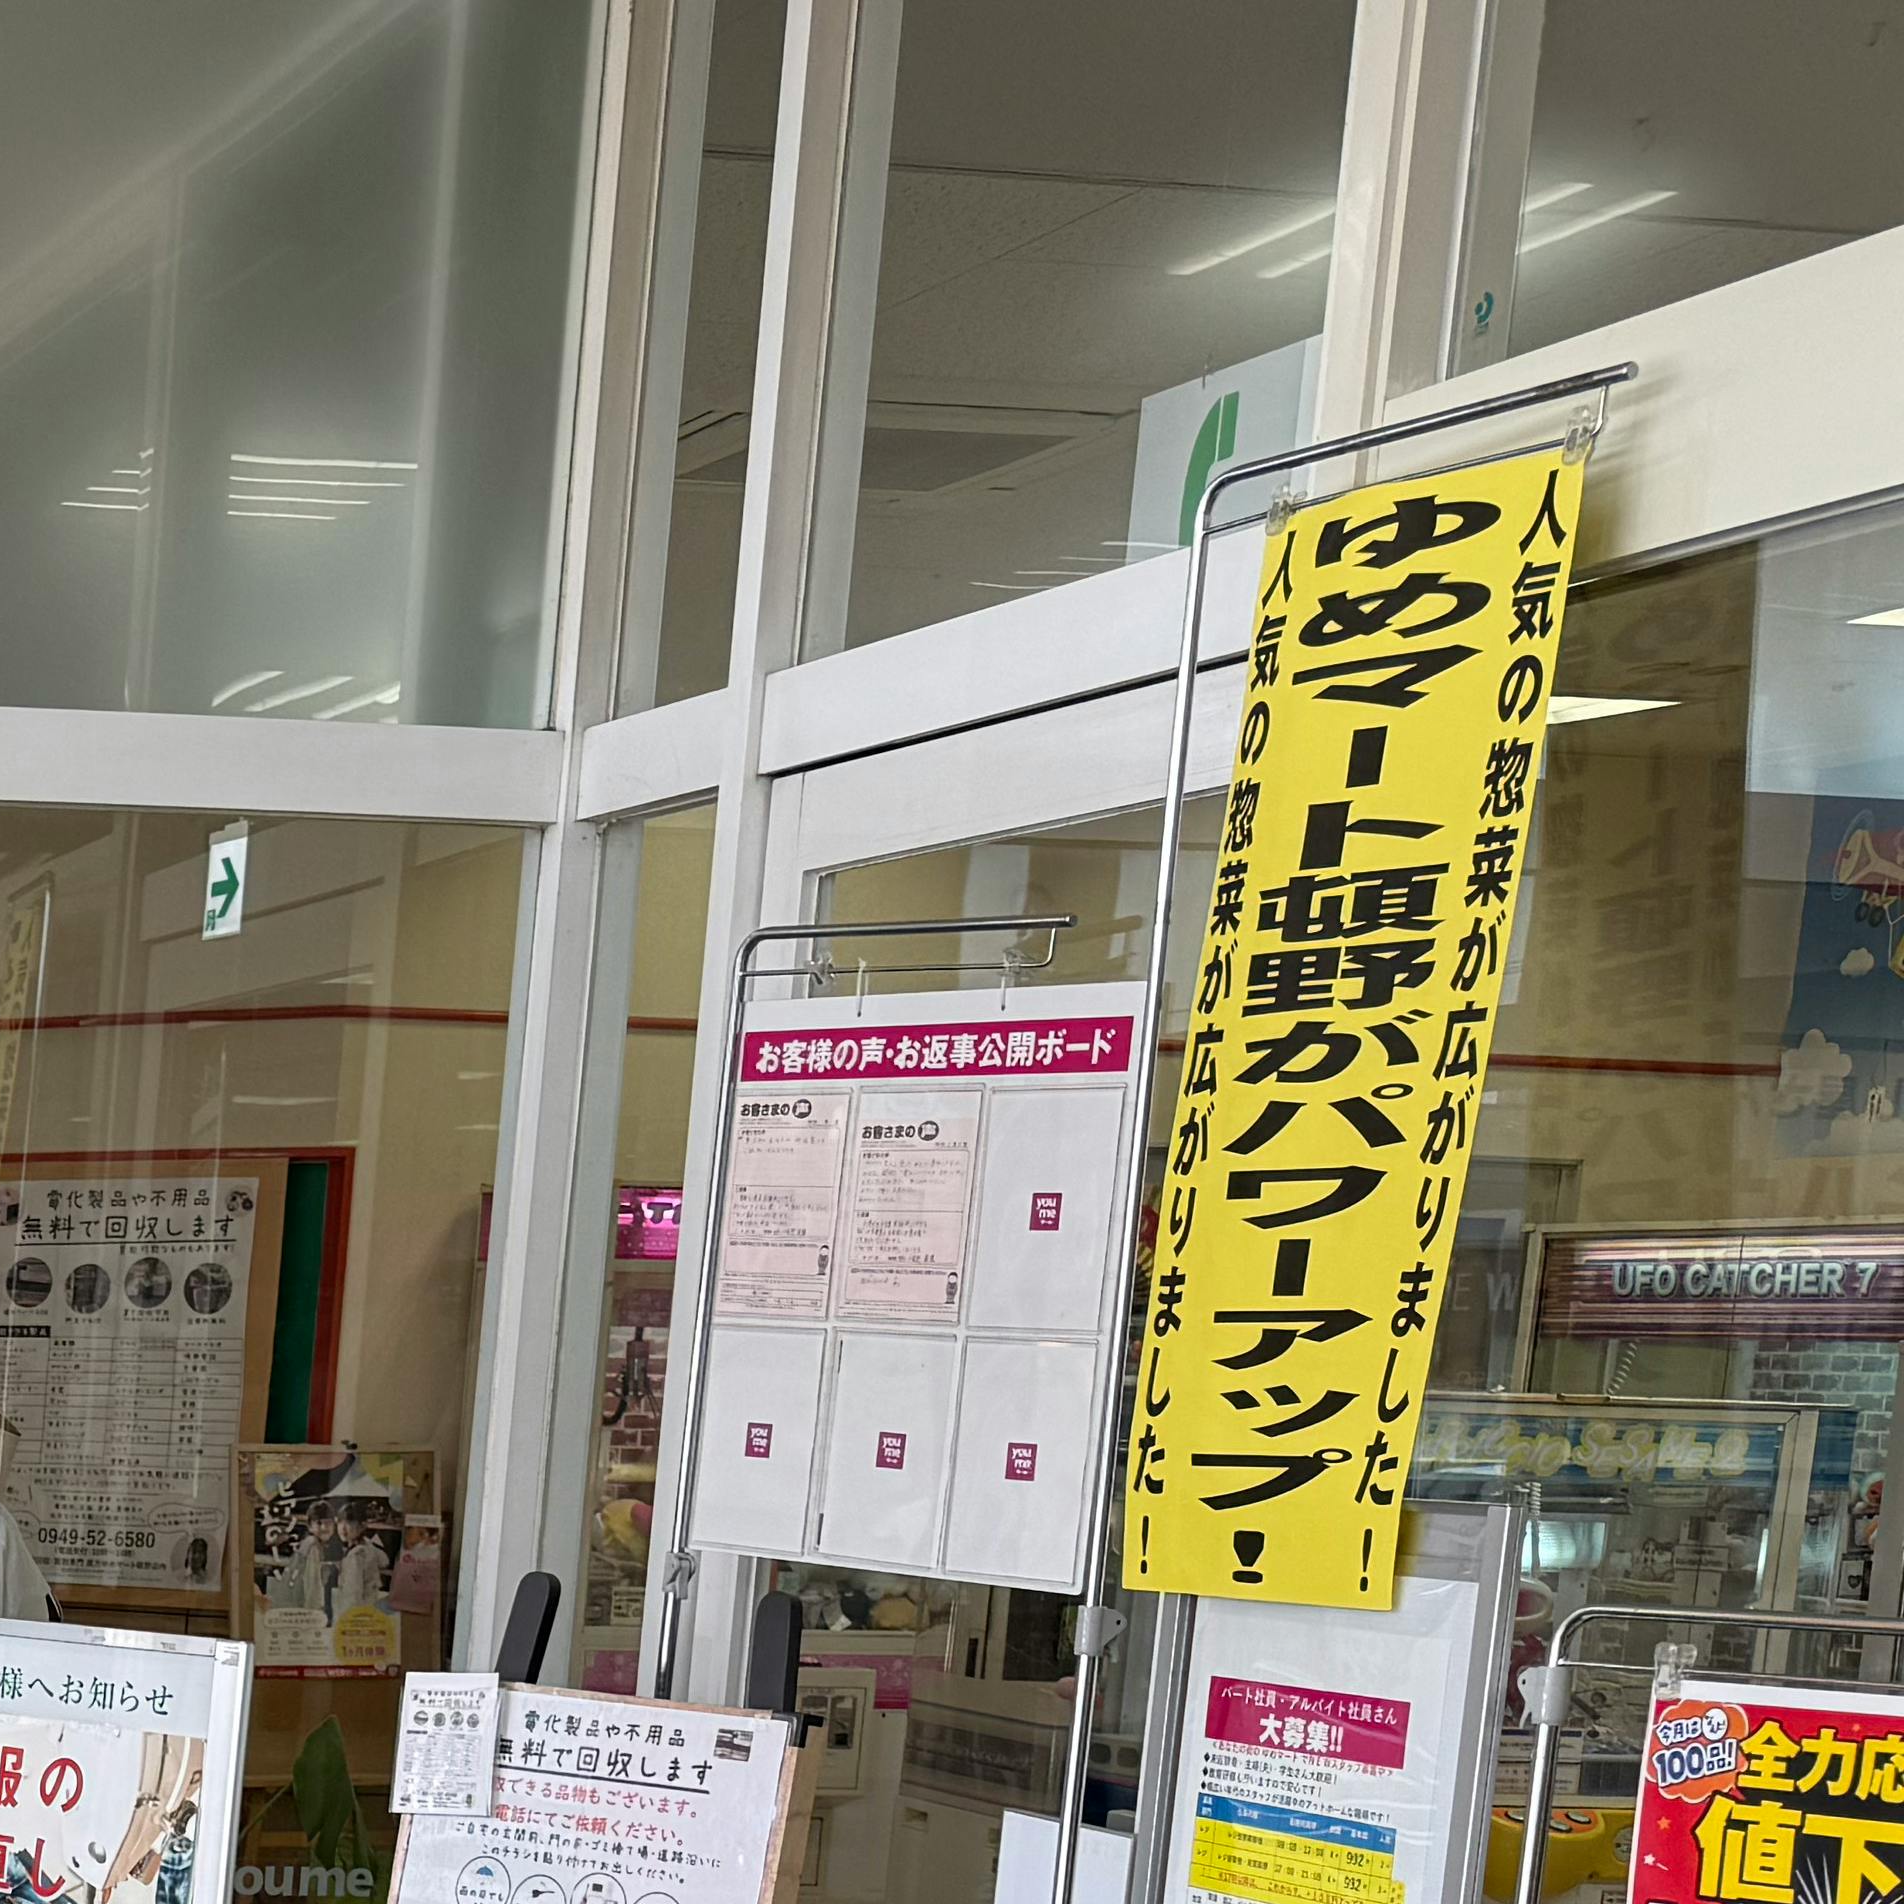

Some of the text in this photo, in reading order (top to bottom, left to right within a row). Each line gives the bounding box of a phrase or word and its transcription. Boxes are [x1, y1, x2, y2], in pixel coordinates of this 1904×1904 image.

[1192, 495, 1501, 1584] ゆめマート頓野がパワーアップ!
[1354, 469, 1567, 1592] 人気の惣菜が広がりました!
[755, 1027, 1117, 1074] お客様の声・お返事公開ボード
[1133, 531, 1297, 1575] 人気の惣菜が広がりました!
[861, 1124, 916, 1140] お客さまの
[47, 1189, 210, 1209] 電化製品や不用品
[1035, 1195, 1058, 1209] you
[1037, 1208, 1058, 1222] me
[21, 1215, 235, 1240] 無料で回収します
[1611, 1260, 1881, 1299] UFO CATCHER 7
[749, 1425, 768, 1439] you
[881, 1435, 902, 1449] you
[1011, 1446, 1033, 1460] you
[38, 1528, 156, 1549] 0949-52-6580
[1221, 1686, 1398, 1726] パート社員・アルバイト社員さん
[524, 1709, 687, 1748] 電化製品や不用品
[1259, 1713, 1344, 1753] 大募集!!
[1656, 1718, 1702, 1743] 今月は
[497, 1737, 715, 1785] 無料で回収します
[1654, 1741, 1736, 1785] 100品!
[235, 1863, 375, 1899] oume
